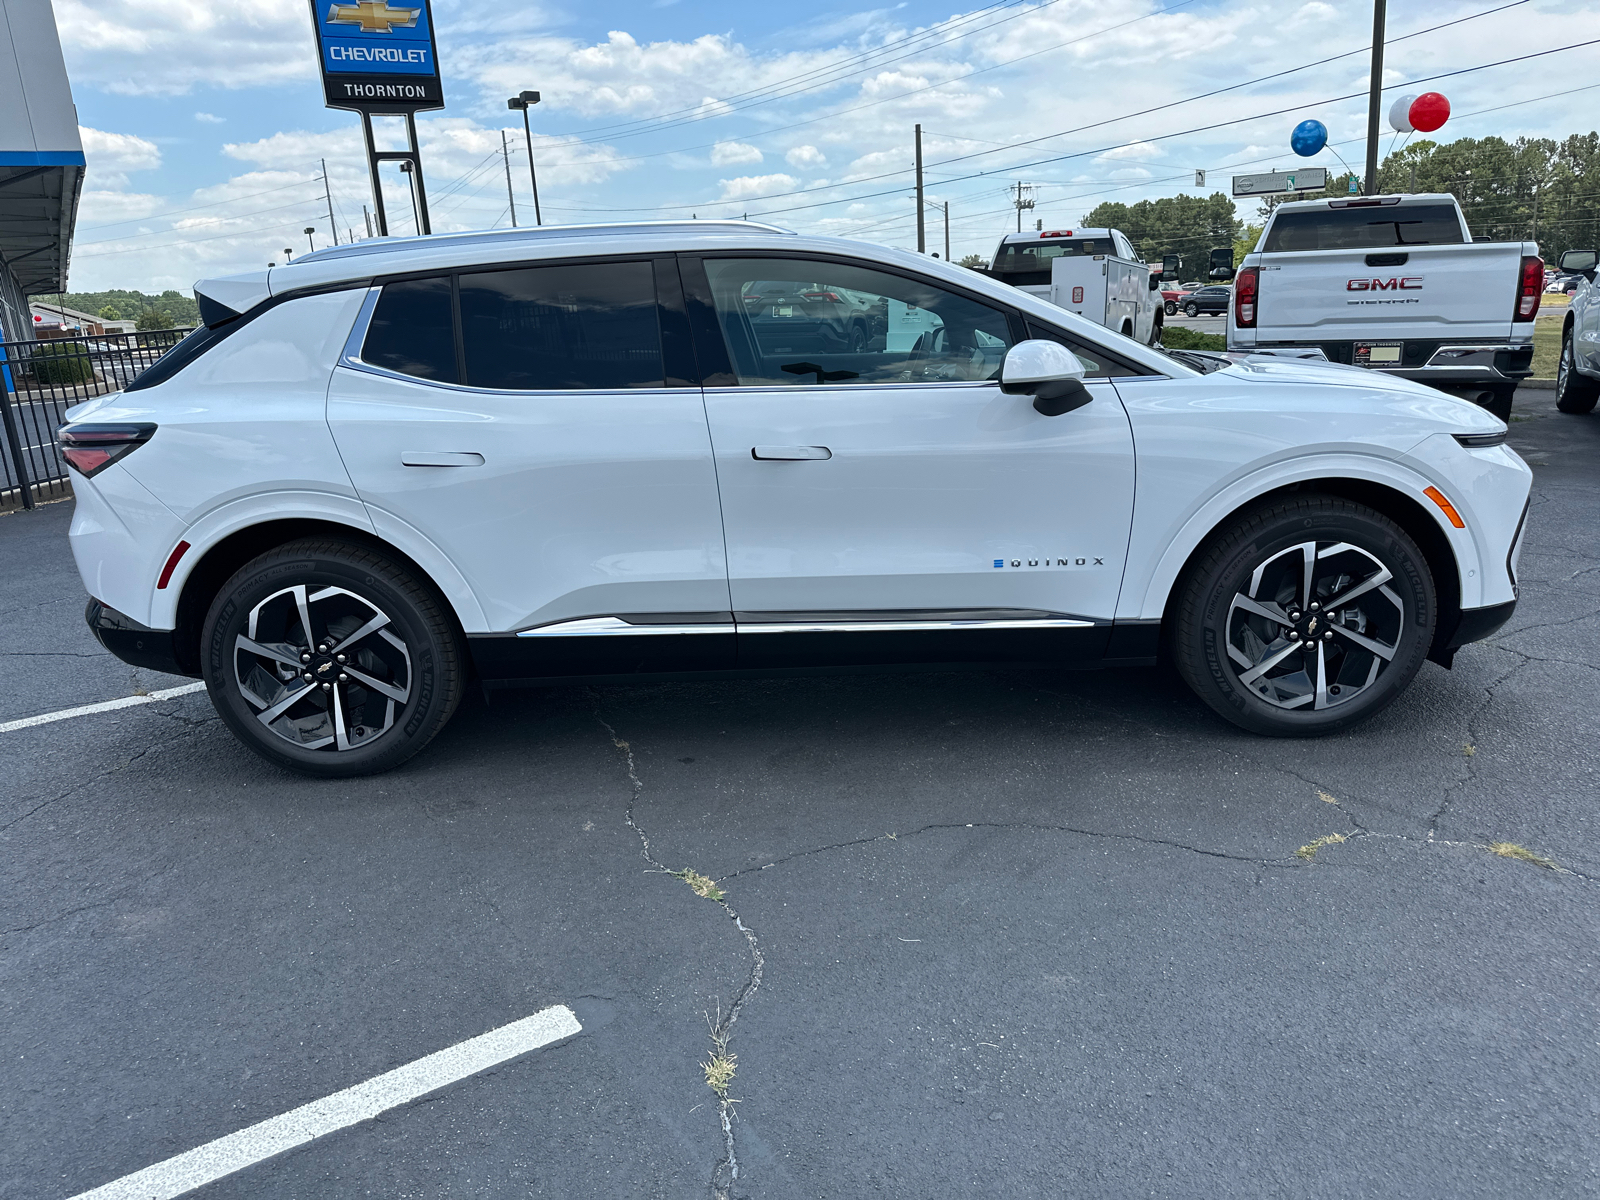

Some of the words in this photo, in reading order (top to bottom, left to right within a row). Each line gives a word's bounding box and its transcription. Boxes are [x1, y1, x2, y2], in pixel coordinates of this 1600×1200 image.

[330, 46, 427, 63] CHEVROLET
[344, 84, 426, 98] THORNTON
[1346, 277, 1424, 292] GMC
[237, 572, 269, 599] PRIMACY
[284, 564, 309, 572] SEASON
[993, 556, 1104, 568] EQUINOX
[1206, 582, 1225, 621] PRIMACY
[1224, 571, 1233, 581] ALL
[1232, 550, 1252, 570] SEASON
[1403, 560, 1426, 625] MICHELIN
[211, 603, 235, 669] MICHELIN
[1205, 630, 1232, 693] MICHELIN
[406, 672, 432, 735] MICHELIN
